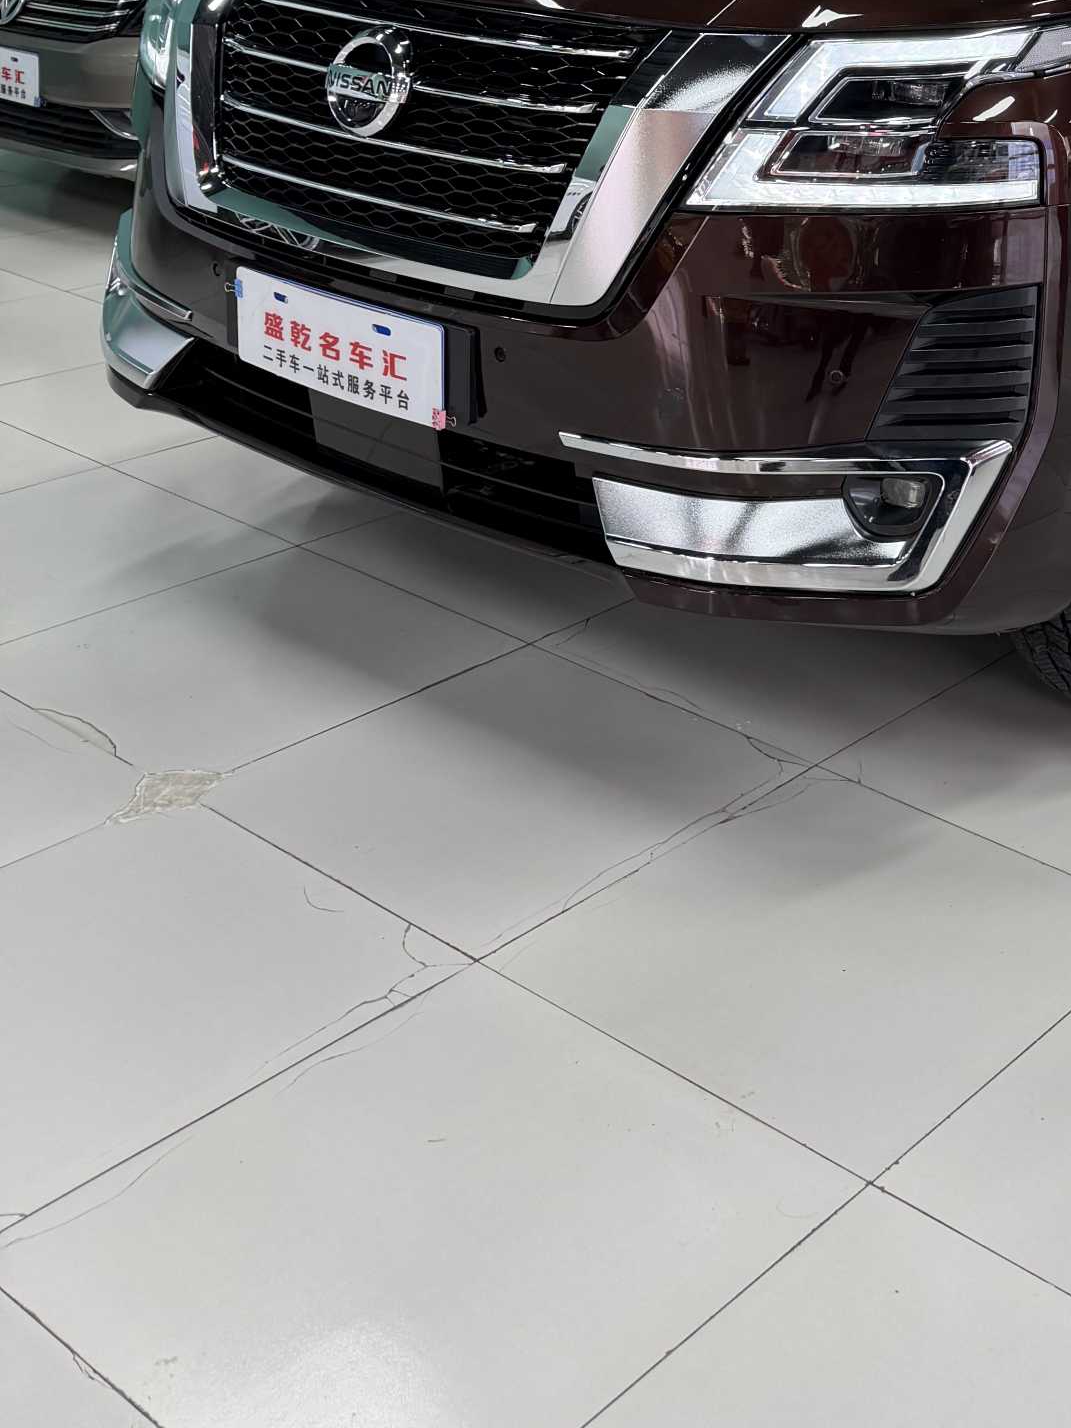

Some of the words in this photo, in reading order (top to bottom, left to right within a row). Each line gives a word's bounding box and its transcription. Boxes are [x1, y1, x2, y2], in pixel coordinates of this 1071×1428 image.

[326, 68, 392, 98] NISSAN
[262, 344, 411, 411] 二手车一站式服务平台
[264, 311, 408, 381] 盛乾名车汇
